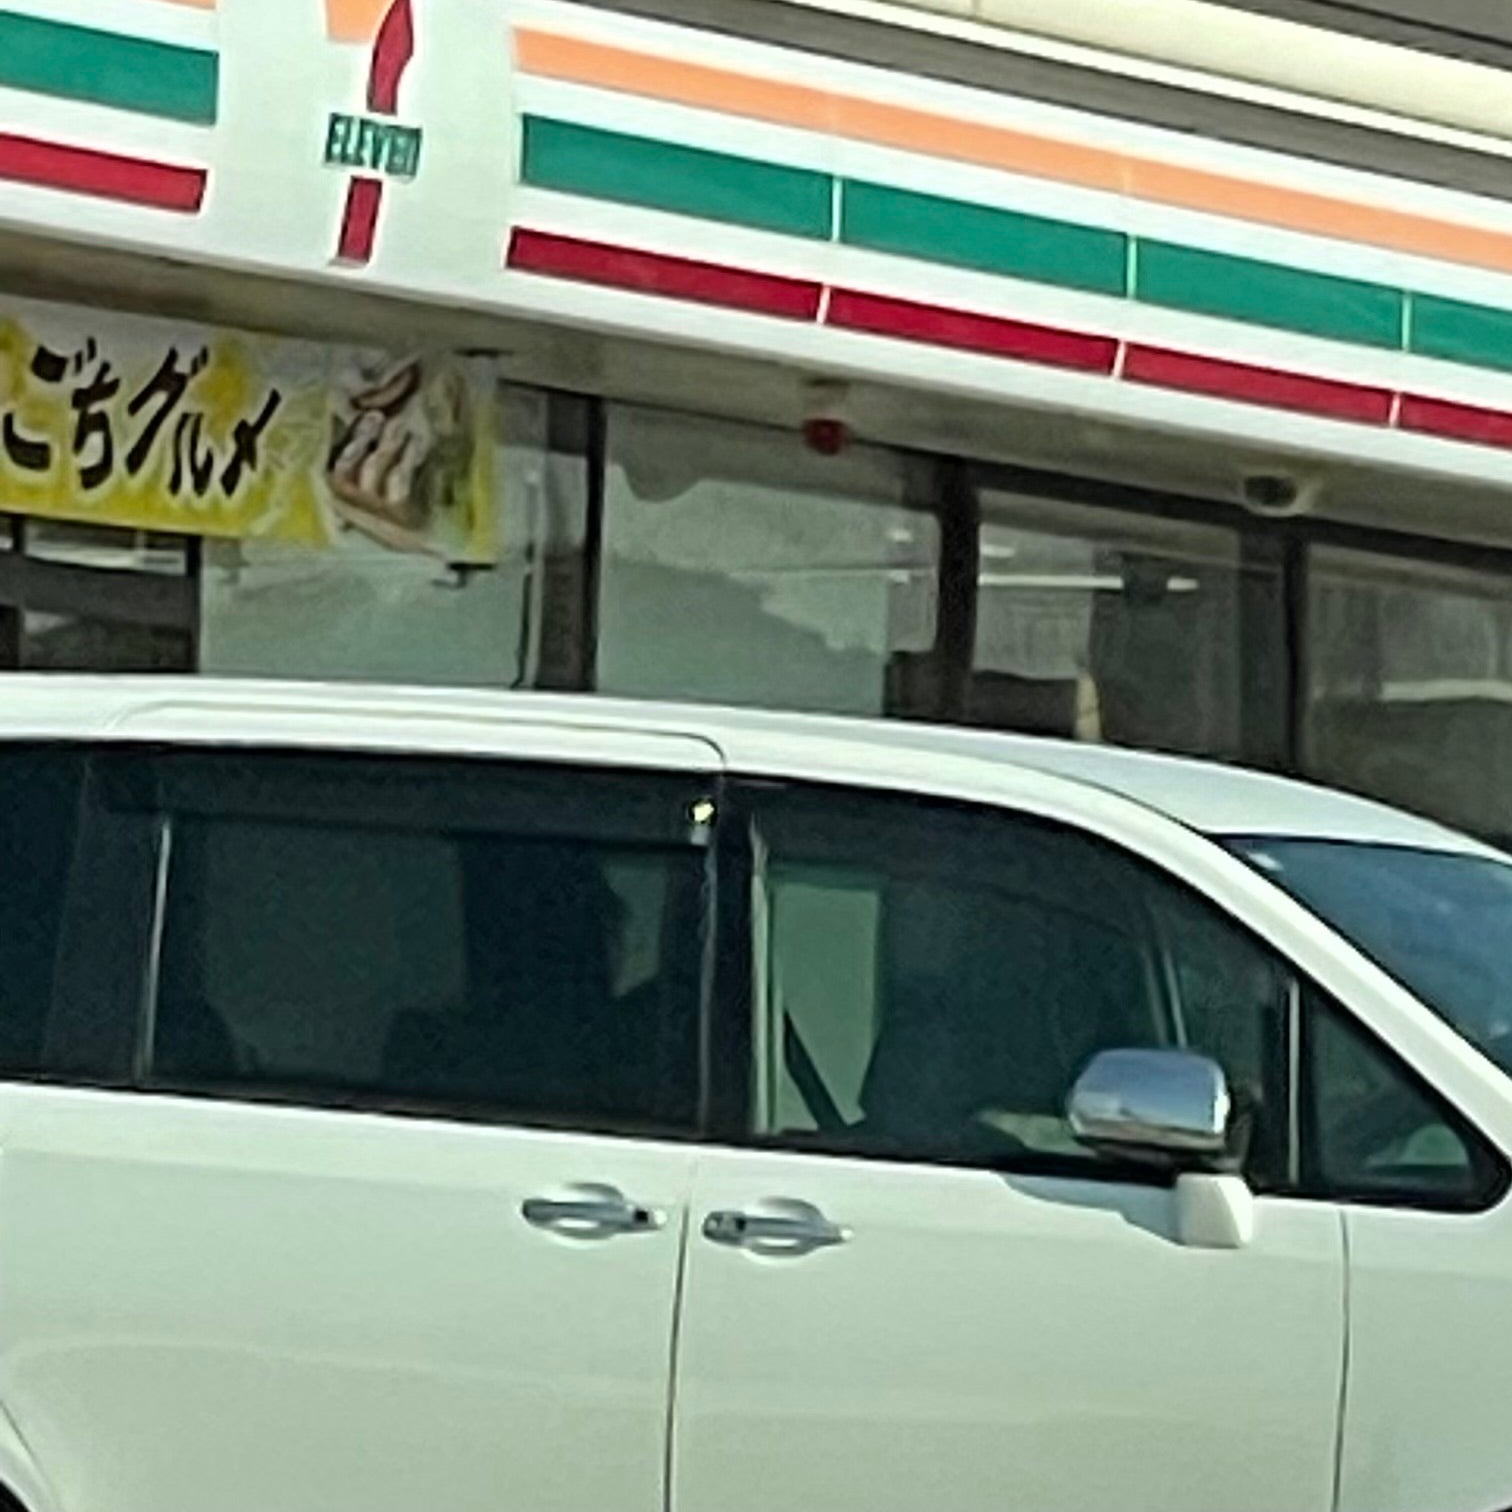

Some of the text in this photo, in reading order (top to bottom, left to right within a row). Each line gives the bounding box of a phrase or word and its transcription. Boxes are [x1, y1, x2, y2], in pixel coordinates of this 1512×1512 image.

[3, 337, 281, 498] ごちグルメ
